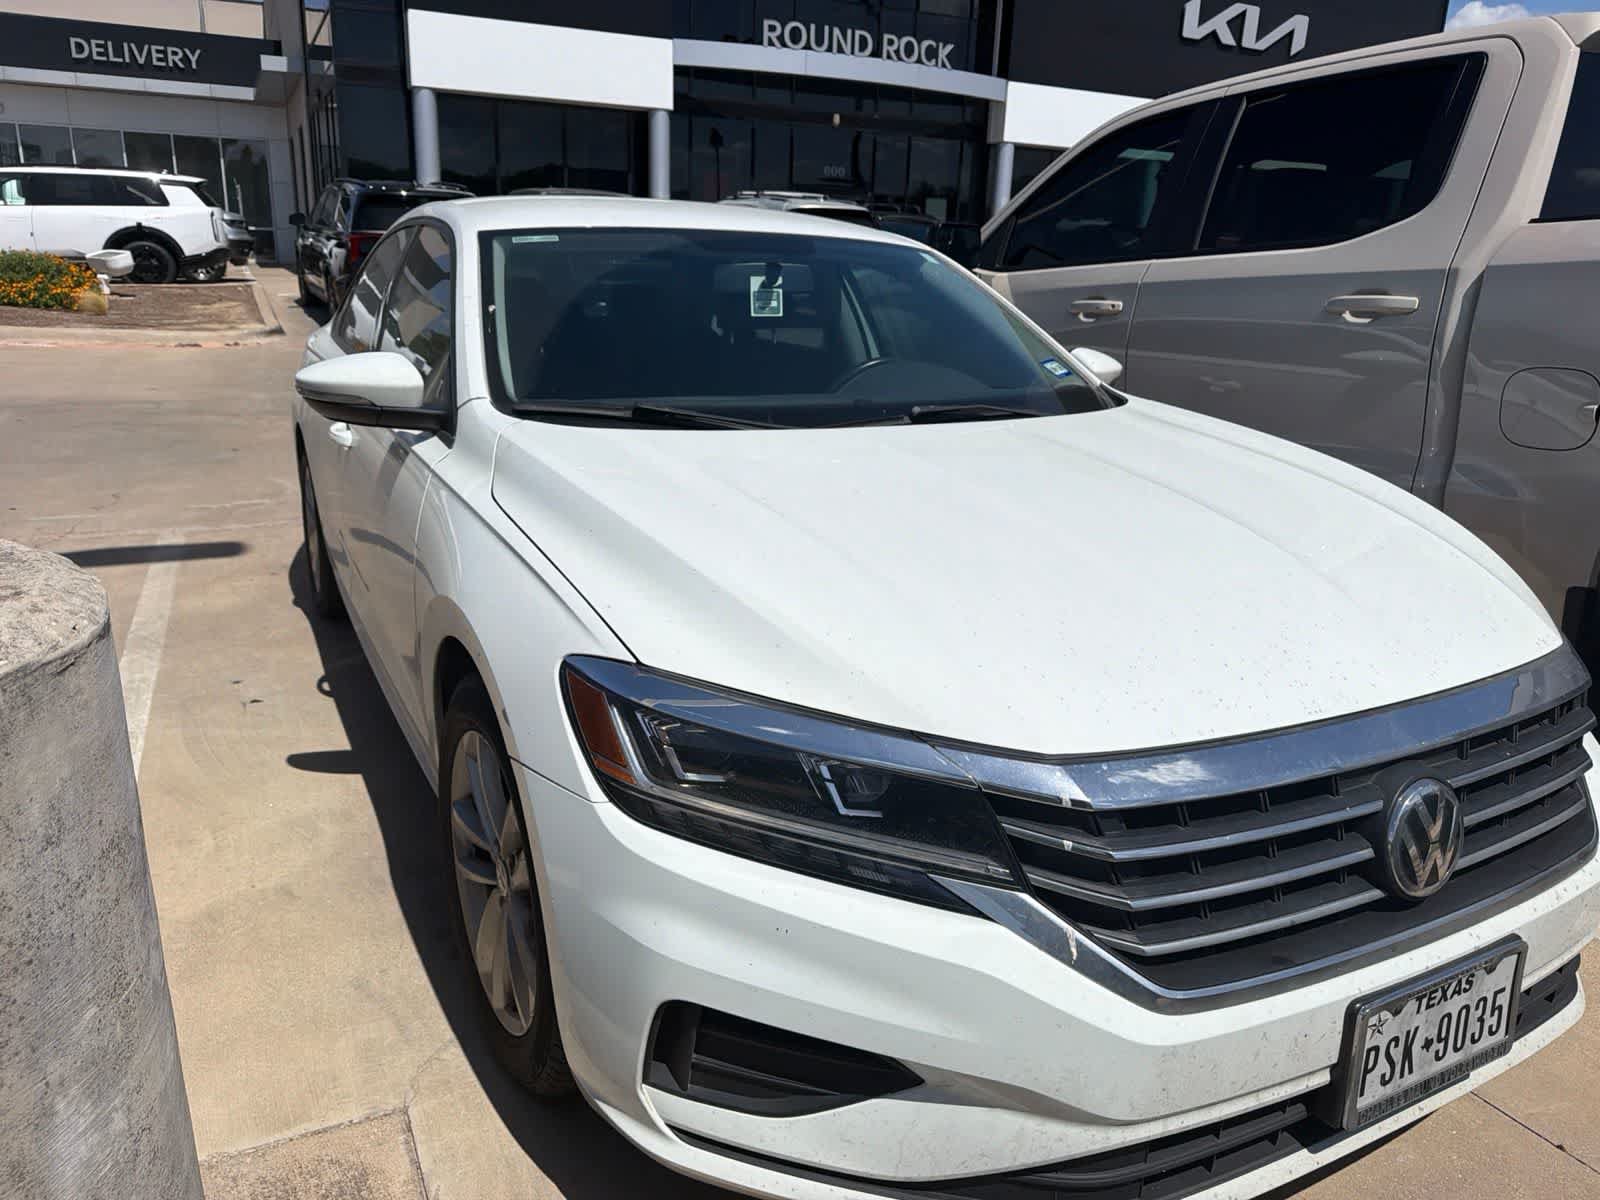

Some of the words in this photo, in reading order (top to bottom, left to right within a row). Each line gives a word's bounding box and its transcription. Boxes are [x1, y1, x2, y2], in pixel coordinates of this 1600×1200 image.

[69, 37, 201, 70] DELIVERY
[762, 18, 873, 57] ROUND
[882, 33, 955, 70] ROCK
[1415, 972, 1476, 1015] TEXAS
